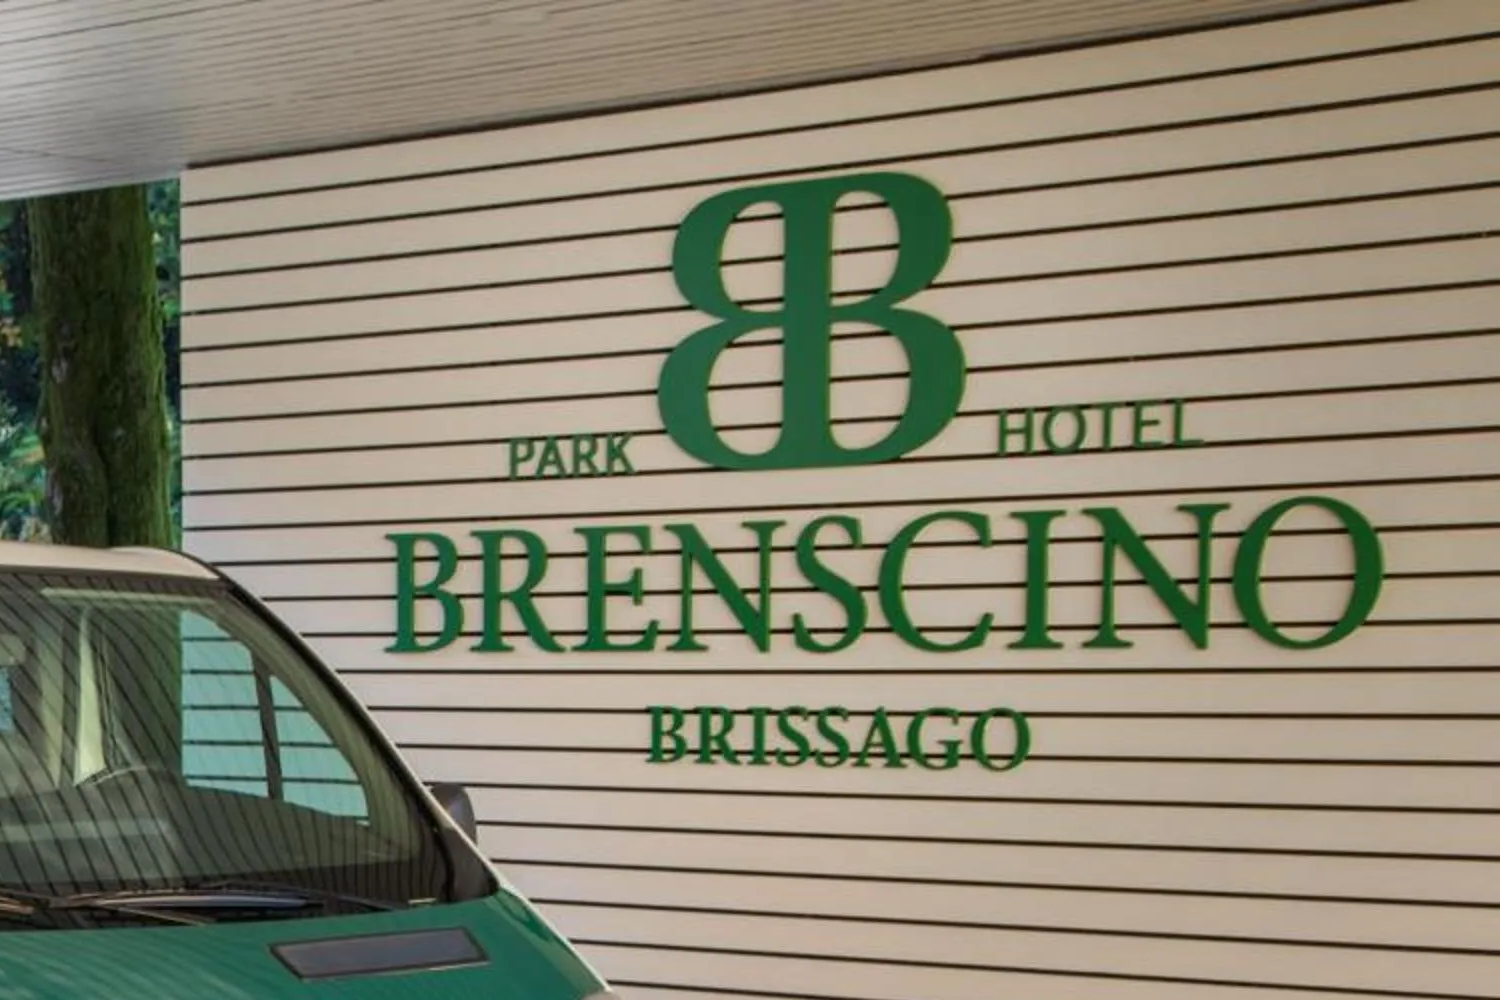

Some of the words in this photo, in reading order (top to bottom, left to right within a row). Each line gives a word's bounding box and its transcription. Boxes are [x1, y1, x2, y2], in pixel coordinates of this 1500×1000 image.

[508, 432, 636, 480] PARK
[996, 400, 1205, 456] HOTEL
[383, 494, 1385, 655] BRENSCINO
[646, 704, 1032, 772] BRISSAGO
